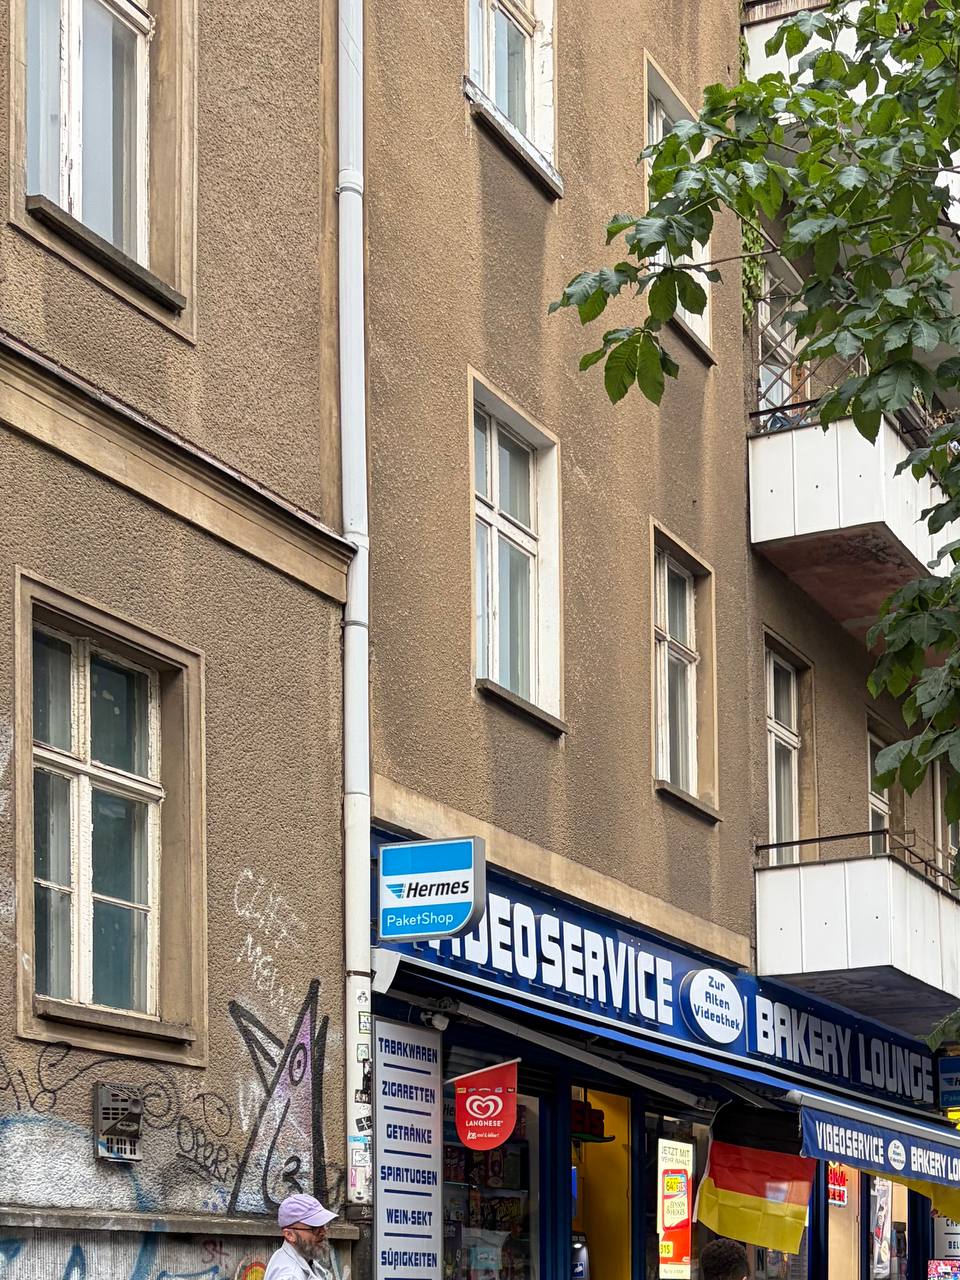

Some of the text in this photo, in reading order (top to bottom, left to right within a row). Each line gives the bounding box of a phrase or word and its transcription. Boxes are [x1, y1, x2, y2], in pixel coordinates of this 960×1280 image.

[406, 880, 470, 898] Hermes
[387, 912, 454, 927] PaketShop
[428, 892, 674, 1027] DEOSERVICE
[708, 976, 726, 992] Zur
[704, 991, 731, 1011] Alten
[693, 1003, 741, 1031] Videothek
[378, 1037, 438, 1064] TABAKWAREN
[756, 995, 934, 1105] BAKERY LOUNGE
[382, 1080, 435, 1104] ZIGARETTEN
[386, 1123, 432, 1144] GETRÄNKE
[816, 1120, 885, 1165] VIDEOSERVICE
[911, 1146, 947, 1179] BAKERY
[380, 1165, 438, 1186] SPIRITUOSEN
[381, 1248, 437, 1270] SÜßIGKEITEN
